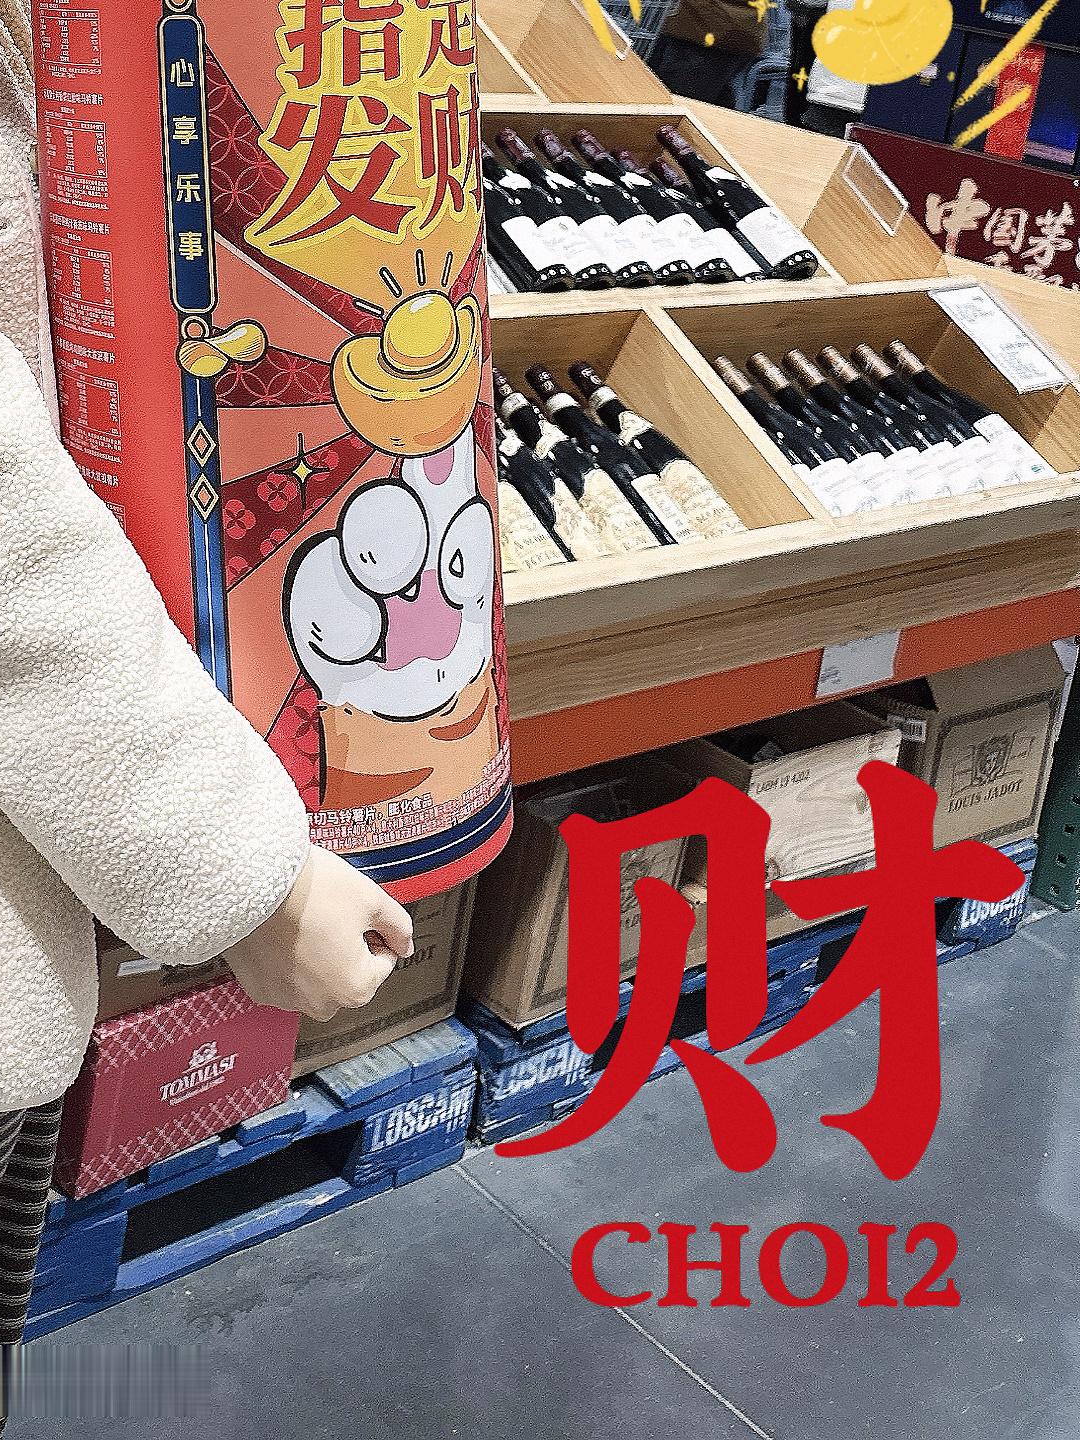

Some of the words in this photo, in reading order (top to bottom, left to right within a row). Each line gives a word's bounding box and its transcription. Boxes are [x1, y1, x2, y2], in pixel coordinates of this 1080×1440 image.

[169, 57, 205, 261] 心享乐事
[253, 82, 482, 248] 发财
[925, 177, 1080, 272] 中国茅
[947, 794, 982, 813] LOUIS
[983, 778, 1023, 802] JADOT
[159, 1052, 239, 1102] TOMMASI
